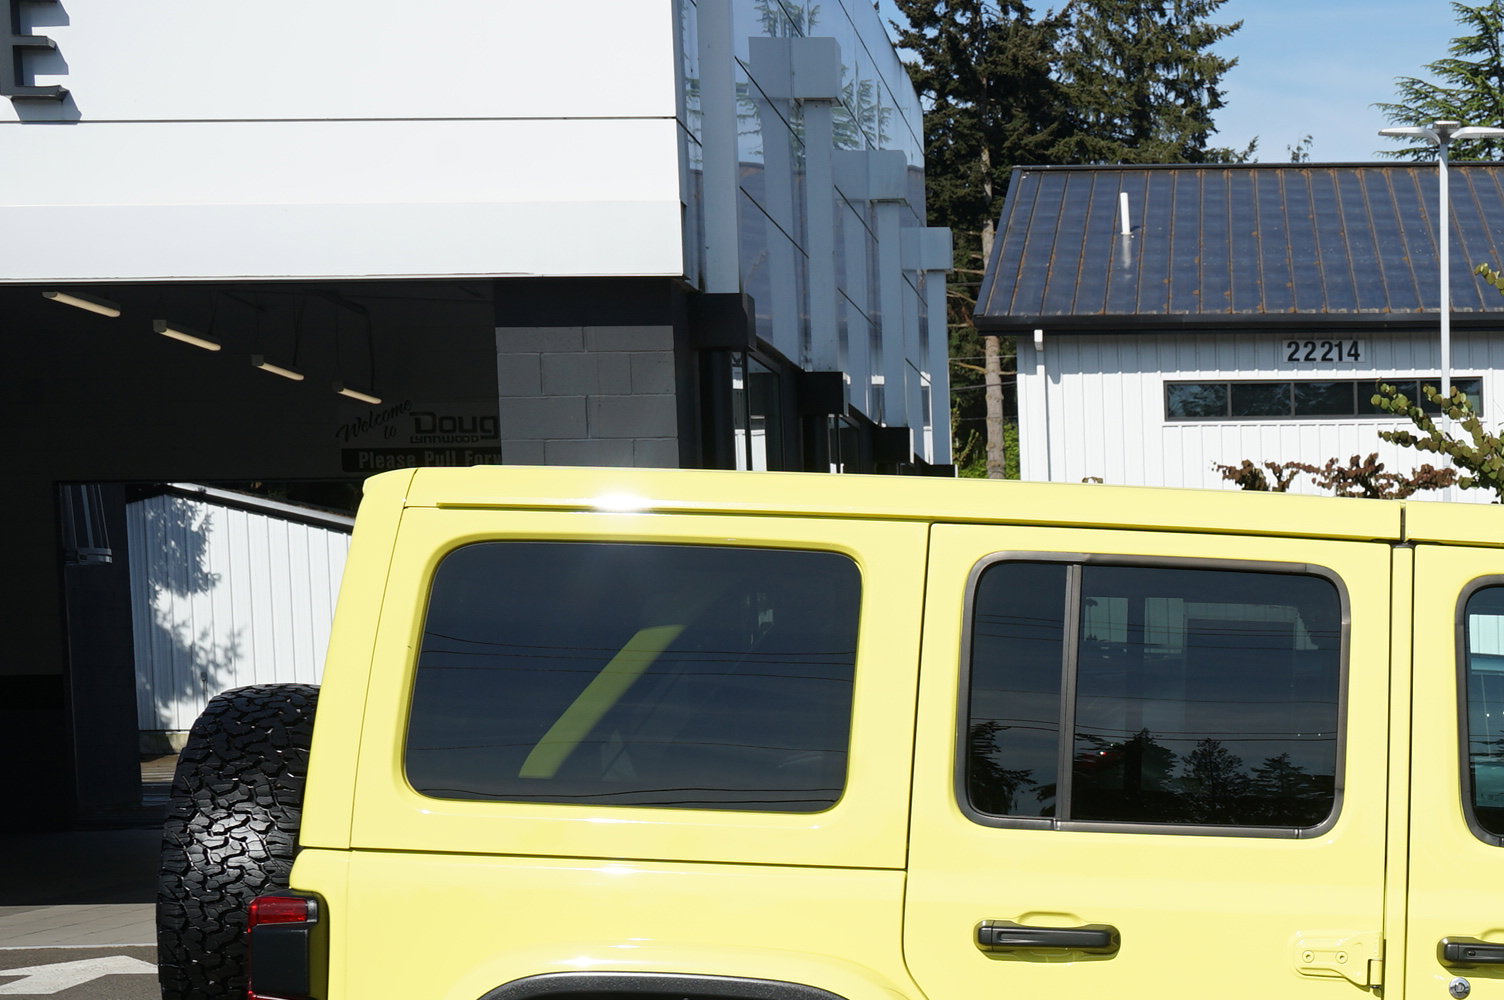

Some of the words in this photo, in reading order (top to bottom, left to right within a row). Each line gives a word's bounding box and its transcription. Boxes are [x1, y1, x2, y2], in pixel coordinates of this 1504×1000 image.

[1286, 341, 1361, 362] 22214
[335, 399, 413, 443] Welcome
[384, 424, 397, 440] to
[358, 451, 416, 469] Please
[424, 450, 456, 467] Pull
